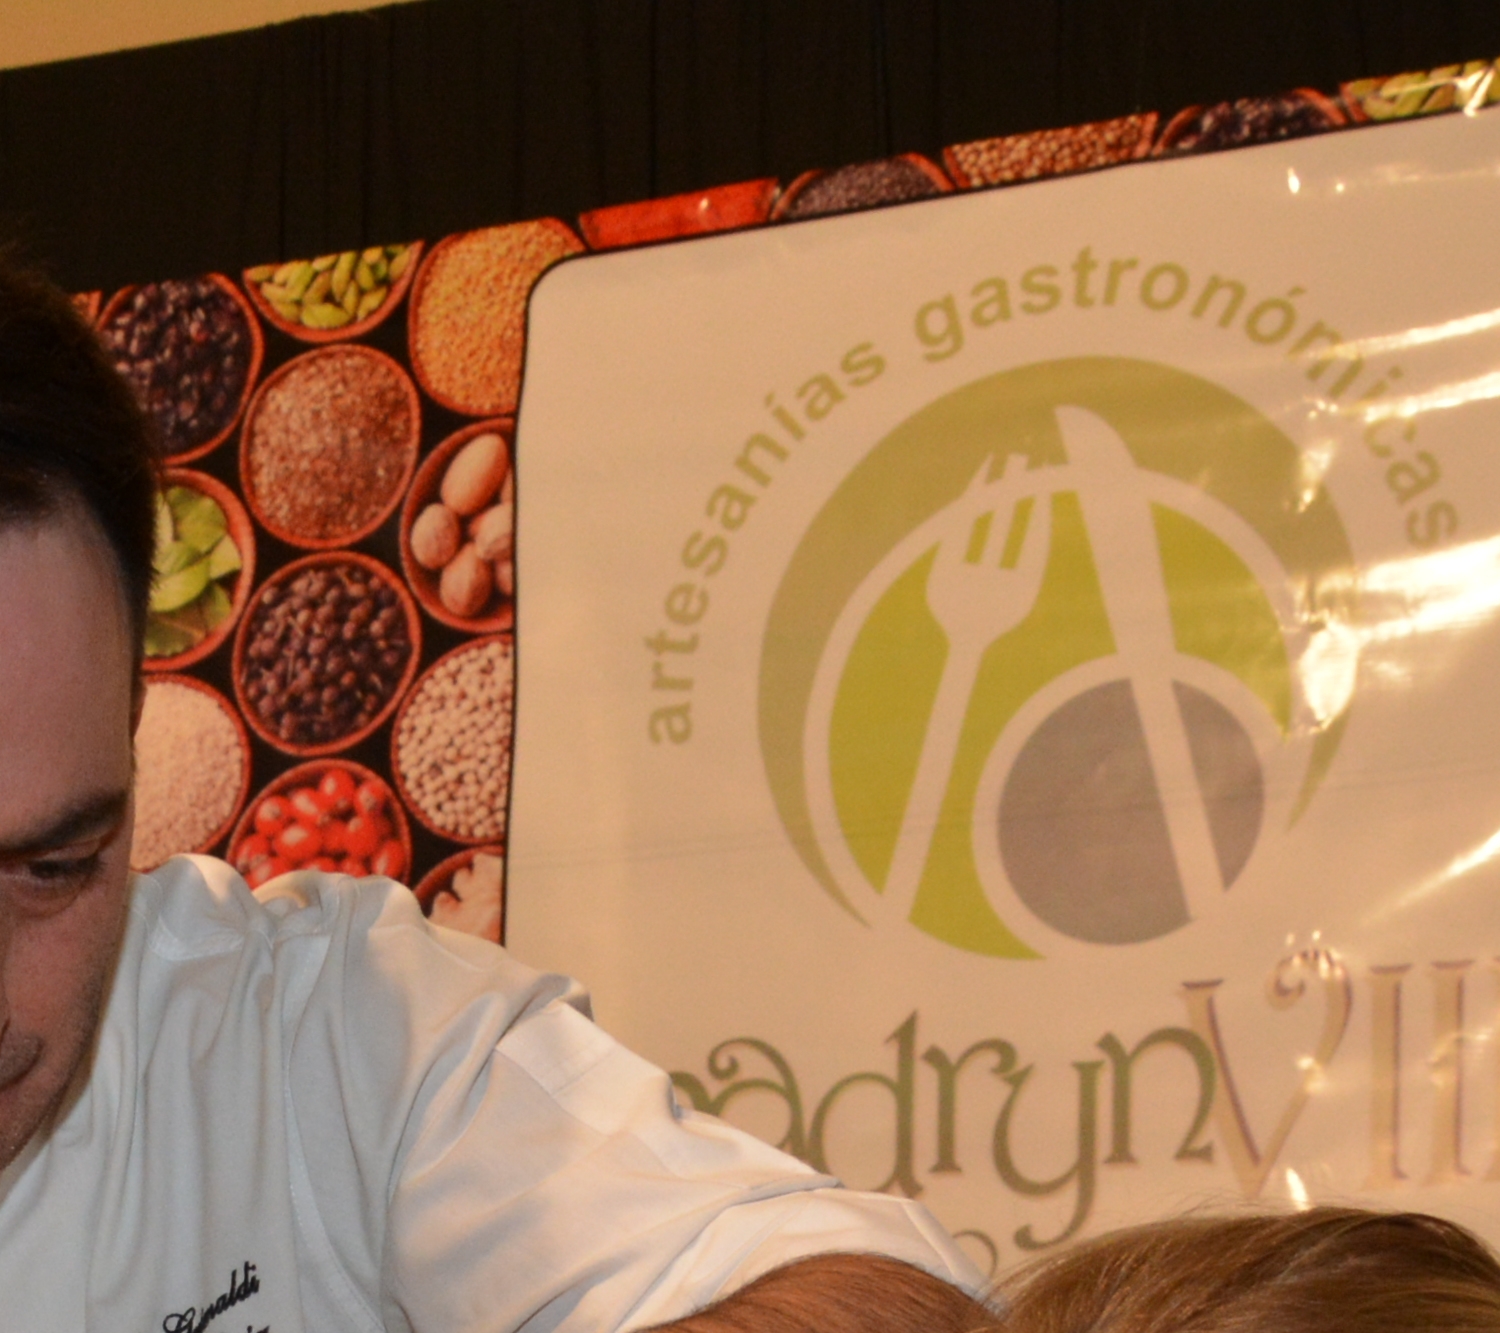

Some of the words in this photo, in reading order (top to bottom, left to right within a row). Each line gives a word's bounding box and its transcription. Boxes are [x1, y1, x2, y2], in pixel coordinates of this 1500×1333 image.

[643, 340, 887, 745] artesanías
[912, 243, 1460, 548] gastronómicas
[669, 1008, 1218, 1251] adryn
